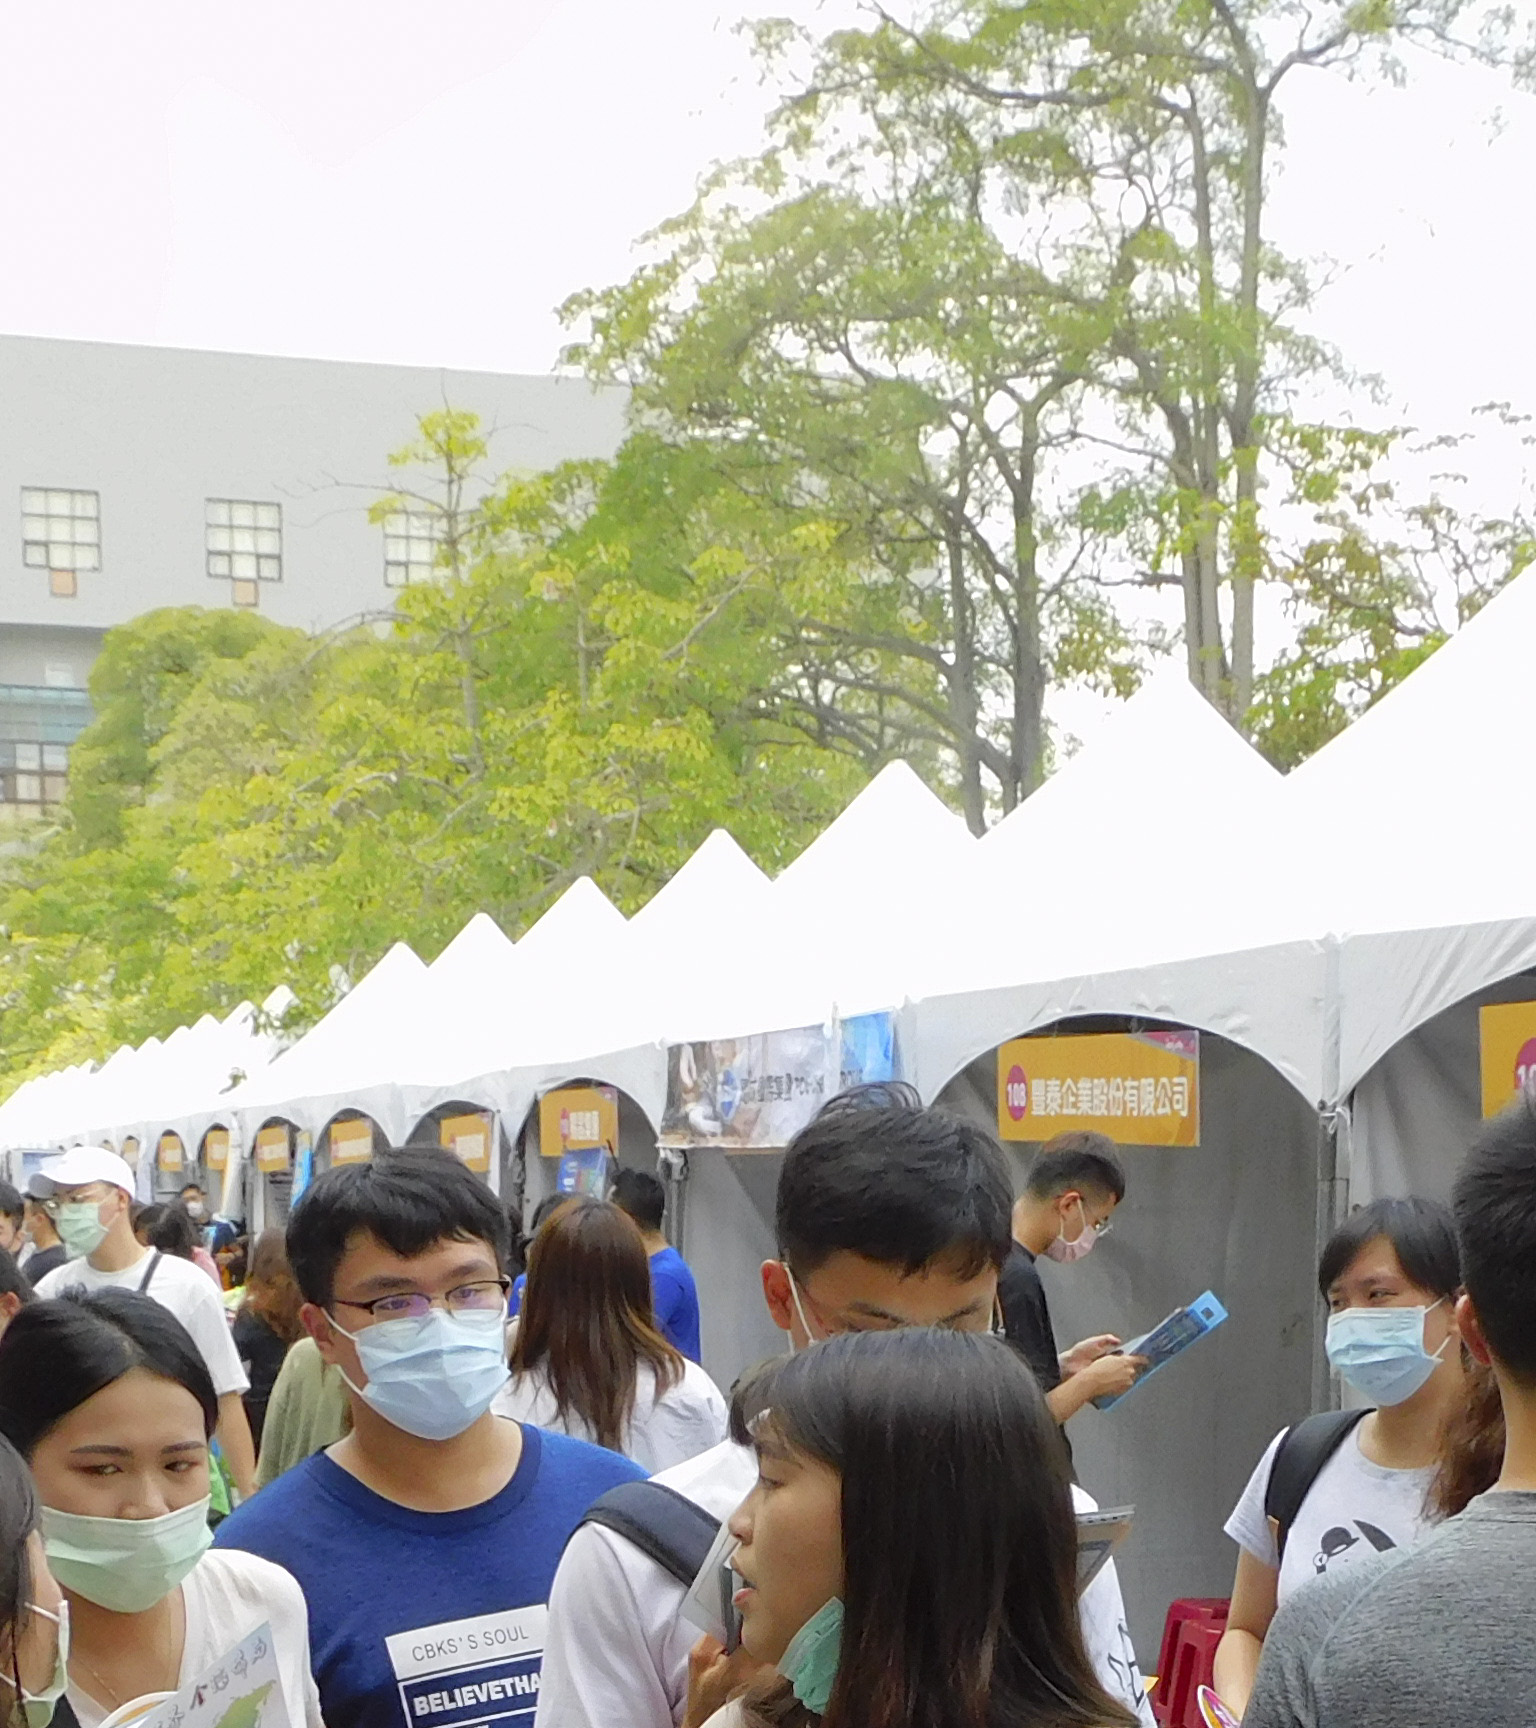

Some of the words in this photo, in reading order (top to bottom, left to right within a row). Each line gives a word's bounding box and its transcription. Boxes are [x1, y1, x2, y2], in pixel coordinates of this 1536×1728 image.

[1031, 1076, 1189, 1117] 豐泰企業股份有限公司
[483, 1625, 529, 1648] SOUL
